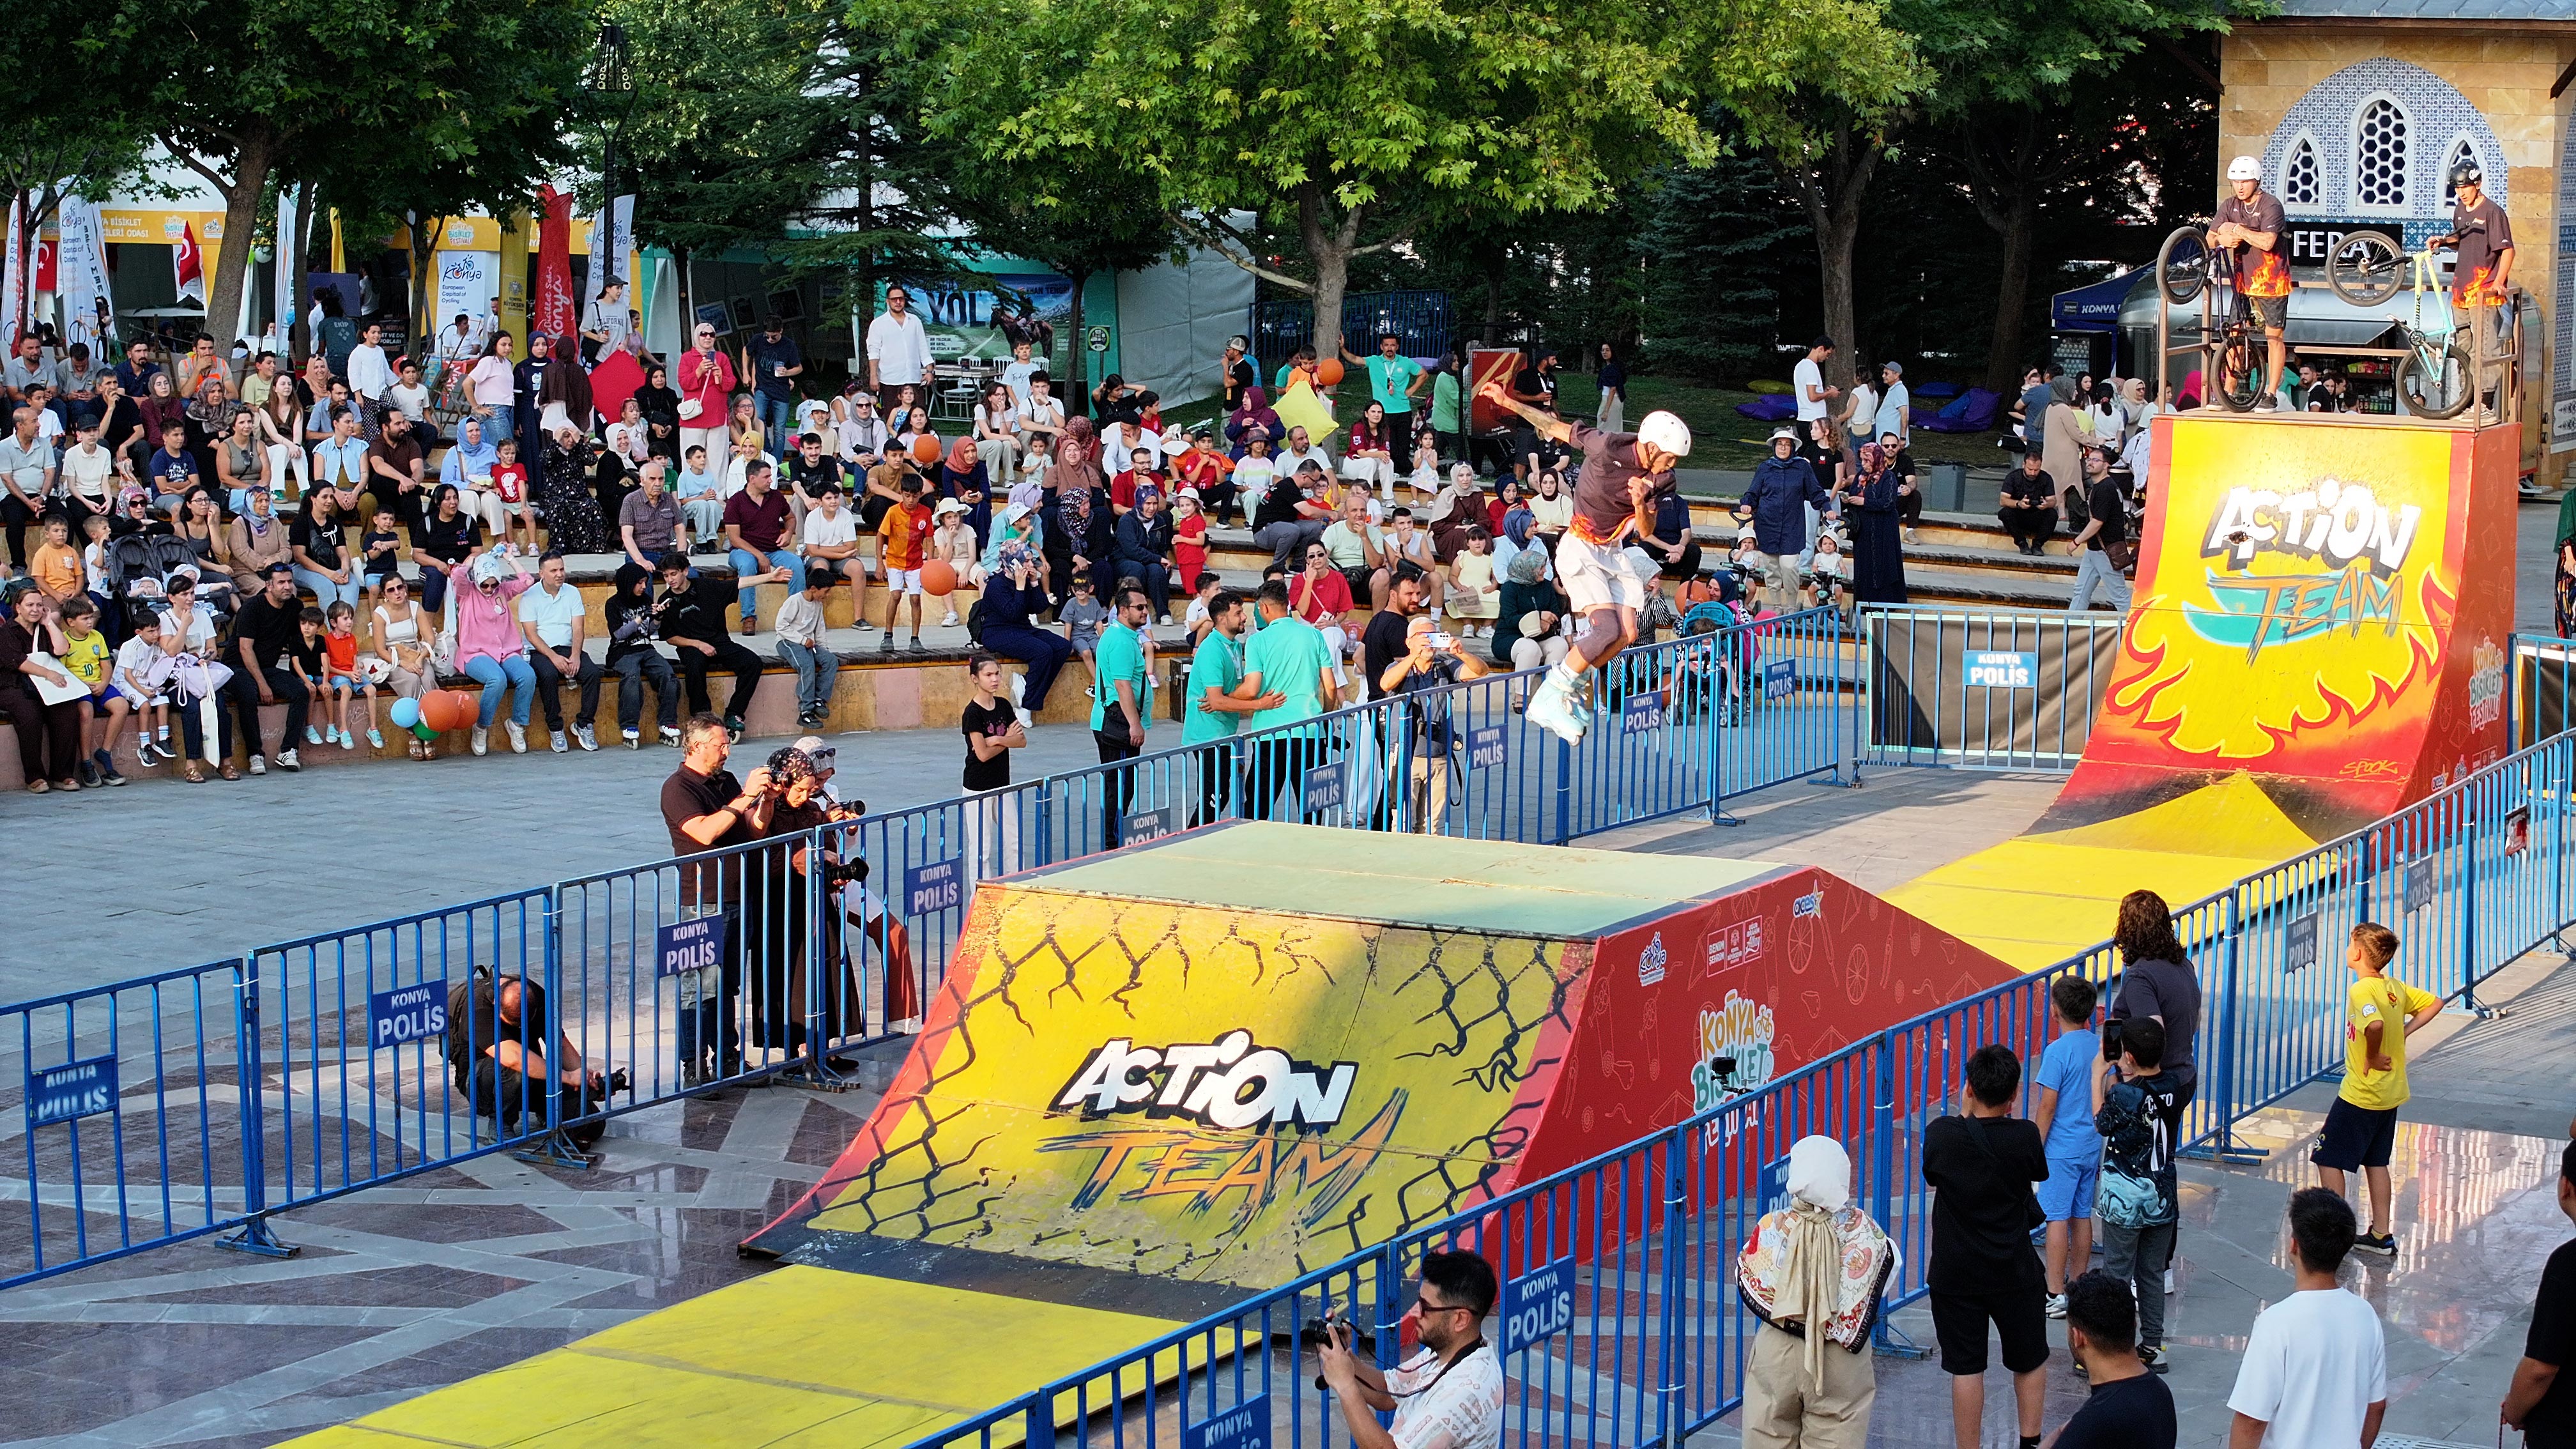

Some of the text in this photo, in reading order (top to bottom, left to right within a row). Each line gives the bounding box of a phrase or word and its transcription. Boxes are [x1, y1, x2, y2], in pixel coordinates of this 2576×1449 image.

[443, 266, 482, 282] Konya
[548, 275, 571, 340] Konya
[927, 292, 986, 327] YOL
[2082, 304, 2116, 314] KONYA
[2207, 567, 2403, 668] TEAM
[1978, 654, 2020, 665] KONYA
[2474, 642, 2497, 672] KONYA
[1768, 674, 1792, 697] POLİS
[1970, 665, 2028, 686] POLİS
[2471, 671, 2501, 705] BİSİKLET
[1633, 696, 1653, 708] KONYA
[1625, 706, 1659, 731] POLİS
[1477, 728, 1499, 743] KONYA
[1473, 741, 1503, 767] POLİS
[1313, 766, 1336, 783] KONYA
[1308, 778, 1340, 810] POLİS
[1133, 815, 1159, 829] KONYA
[920, 863, 952, 884] KONYA
[914, 880, 958, 913] POLİS
[673, 921, 709, 941] KONYA
[2293, 919, 2311, 939] KONYA
[666, 939, 716, 975] POLİS
[1639, 950, 1666, 975] Konya
[2288, 935, 2313, 970] POLİS
[392, 988, 431, 1009] KONYA
[379, 1002, 446, 1045] POLİS
[1702, 1000, 1755, 1062] KONYA
[1035, 1087, 1409, 1236] TEAM
[1521, 1270, 1559, 1301] KONYA
[1508, 1289, 1570, 1349] POLİS
[1204, 1409, 1252, 1448] KONYA
